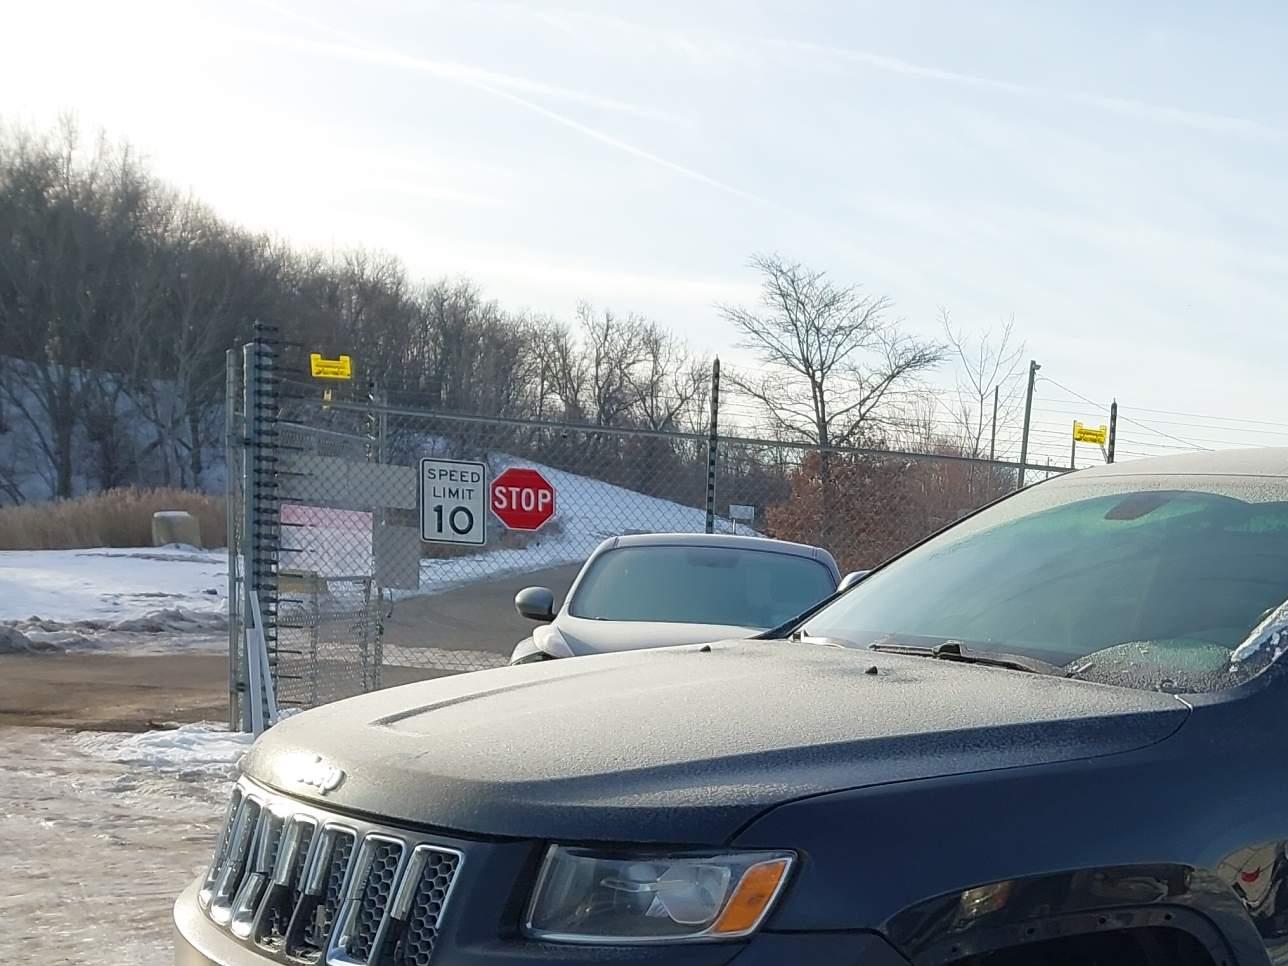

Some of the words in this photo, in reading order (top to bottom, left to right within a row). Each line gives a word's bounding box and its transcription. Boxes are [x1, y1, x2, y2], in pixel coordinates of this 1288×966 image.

[427, 468, 480, 483] SPEED
[433, 486, 474, 500] LIMIT
[494, 486, 552, 512] STOP
[433, 504, 474, 535] 10
